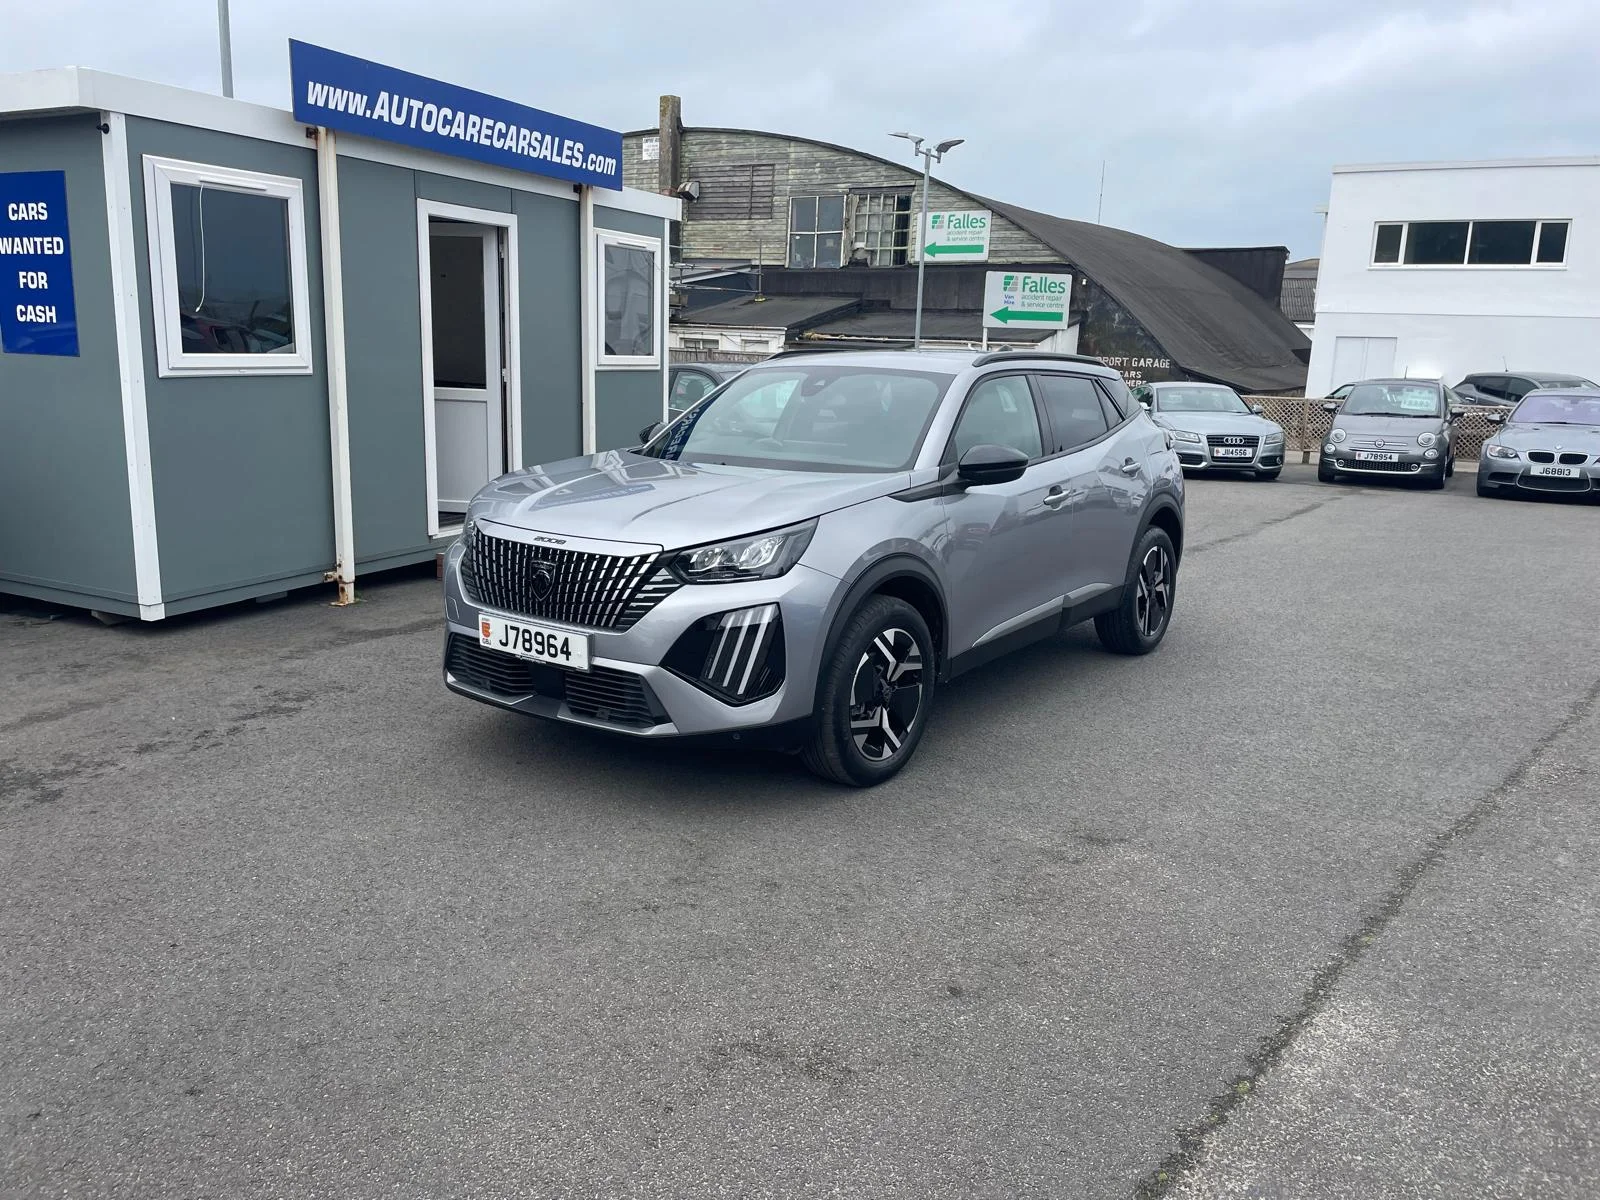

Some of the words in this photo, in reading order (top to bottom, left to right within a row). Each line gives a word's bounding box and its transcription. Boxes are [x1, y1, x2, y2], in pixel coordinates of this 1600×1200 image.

[307, 81, 616, 176] www.AUTOCARECARSALES.com
[8, 202, 48, 221] CARS
[947, 213, 986, 229] Falles
[0, 236, 64, 255] WANTED
[18, 271, 48, 289] FOR
[1022, 276, 1066, 293] Falles
[16, 304, 57, 323] CASH
[1132, 357, 1171, 369] GARAGE
[1539, 467, 1571, 476] J68813
[533, 536, 567, 545] 2008
[499, 624, 571, 661] J78964
